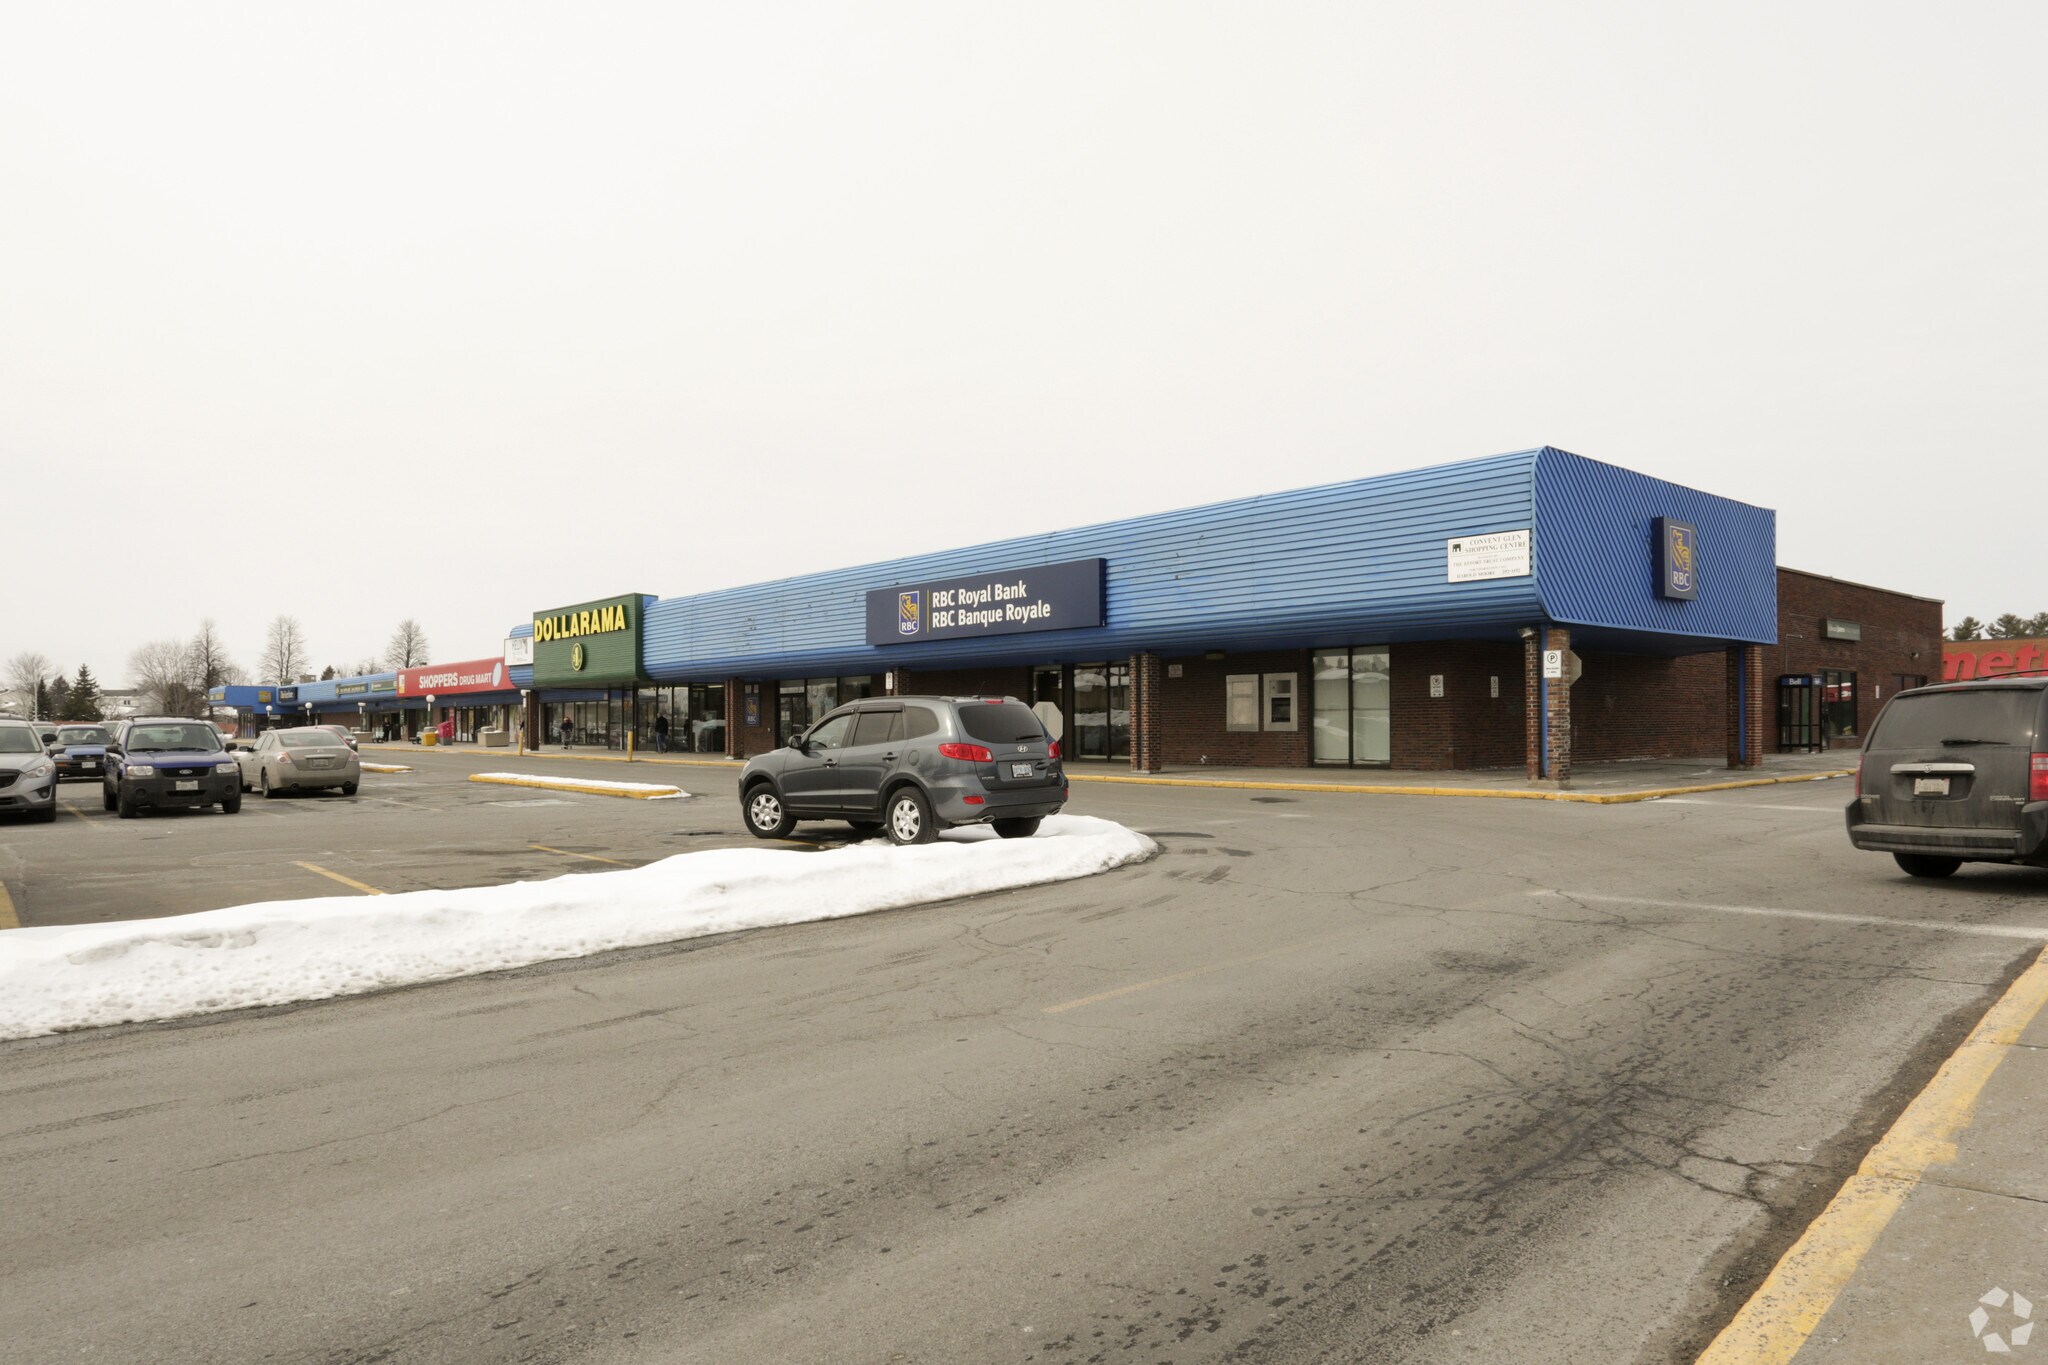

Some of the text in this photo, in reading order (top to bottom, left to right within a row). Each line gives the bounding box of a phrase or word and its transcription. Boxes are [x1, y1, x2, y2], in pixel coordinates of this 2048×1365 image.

[1465, 541, 1526, 553] SHOPPING CENTRE
[1469, 534, 1522, 546] CONVENT GLEN
[1673, 570, 1690, 587] RBC
[932, 580, 1027, 609] RBC Royal Bank
[534, 604, 626, 642] DOLLARAMA
[932, 600, 1051, 629] RBC Banque Royale
[901, 620, 917, 632] RBC
[418, 672, 458, 690] SHOPPERS
[459, 674, 475, 686] DRUG
[475, 672, 492, 684] MART
[1789, 677, 1802, 686] Bell
